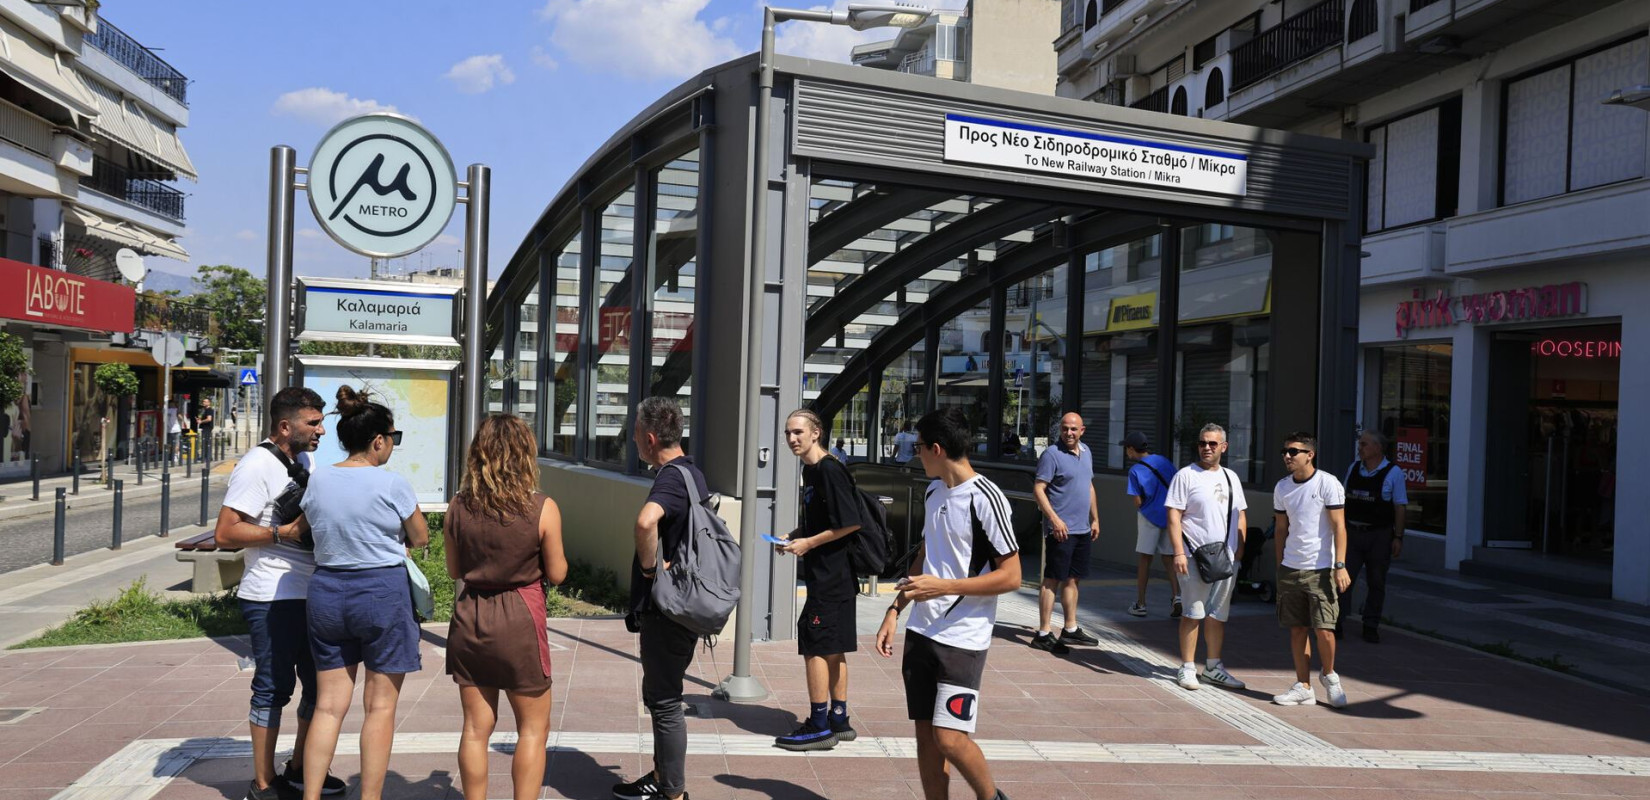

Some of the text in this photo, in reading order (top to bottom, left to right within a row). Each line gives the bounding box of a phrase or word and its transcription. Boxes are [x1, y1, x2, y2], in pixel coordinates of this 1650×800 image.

[959, 125, 998, 147] Προς
[1002, 130, 1029, 148] Νέο
[1033, 135, 1137, 163] Σιδηροδρομικό
[1141, 149, 1188, 169] Σταθμό
[1199, 156, 1236, 176] Μίκρα
[1025, 154, 1038, 166] To
[1041, 155, 1065, 169] New
[1067, 159, 1108, 177] Railway
[1110, 165, 1146, 180] Station
[1154, 170, 1181, 184] Mikra
[359, 204, 408, 218] METRO
[26, 269, 86, 317] LABOTE
[337, 298, 421, 317] Καλαμαριά
[1121, 303, 1149, 323] Piraeus
[1395, 282, 1586, 339] pink woman
[349, 319, 408, 332] Kalamaria
[1397, 442, 1424, 454] FINAL
[1397, 452, 1421, 464] SALE
